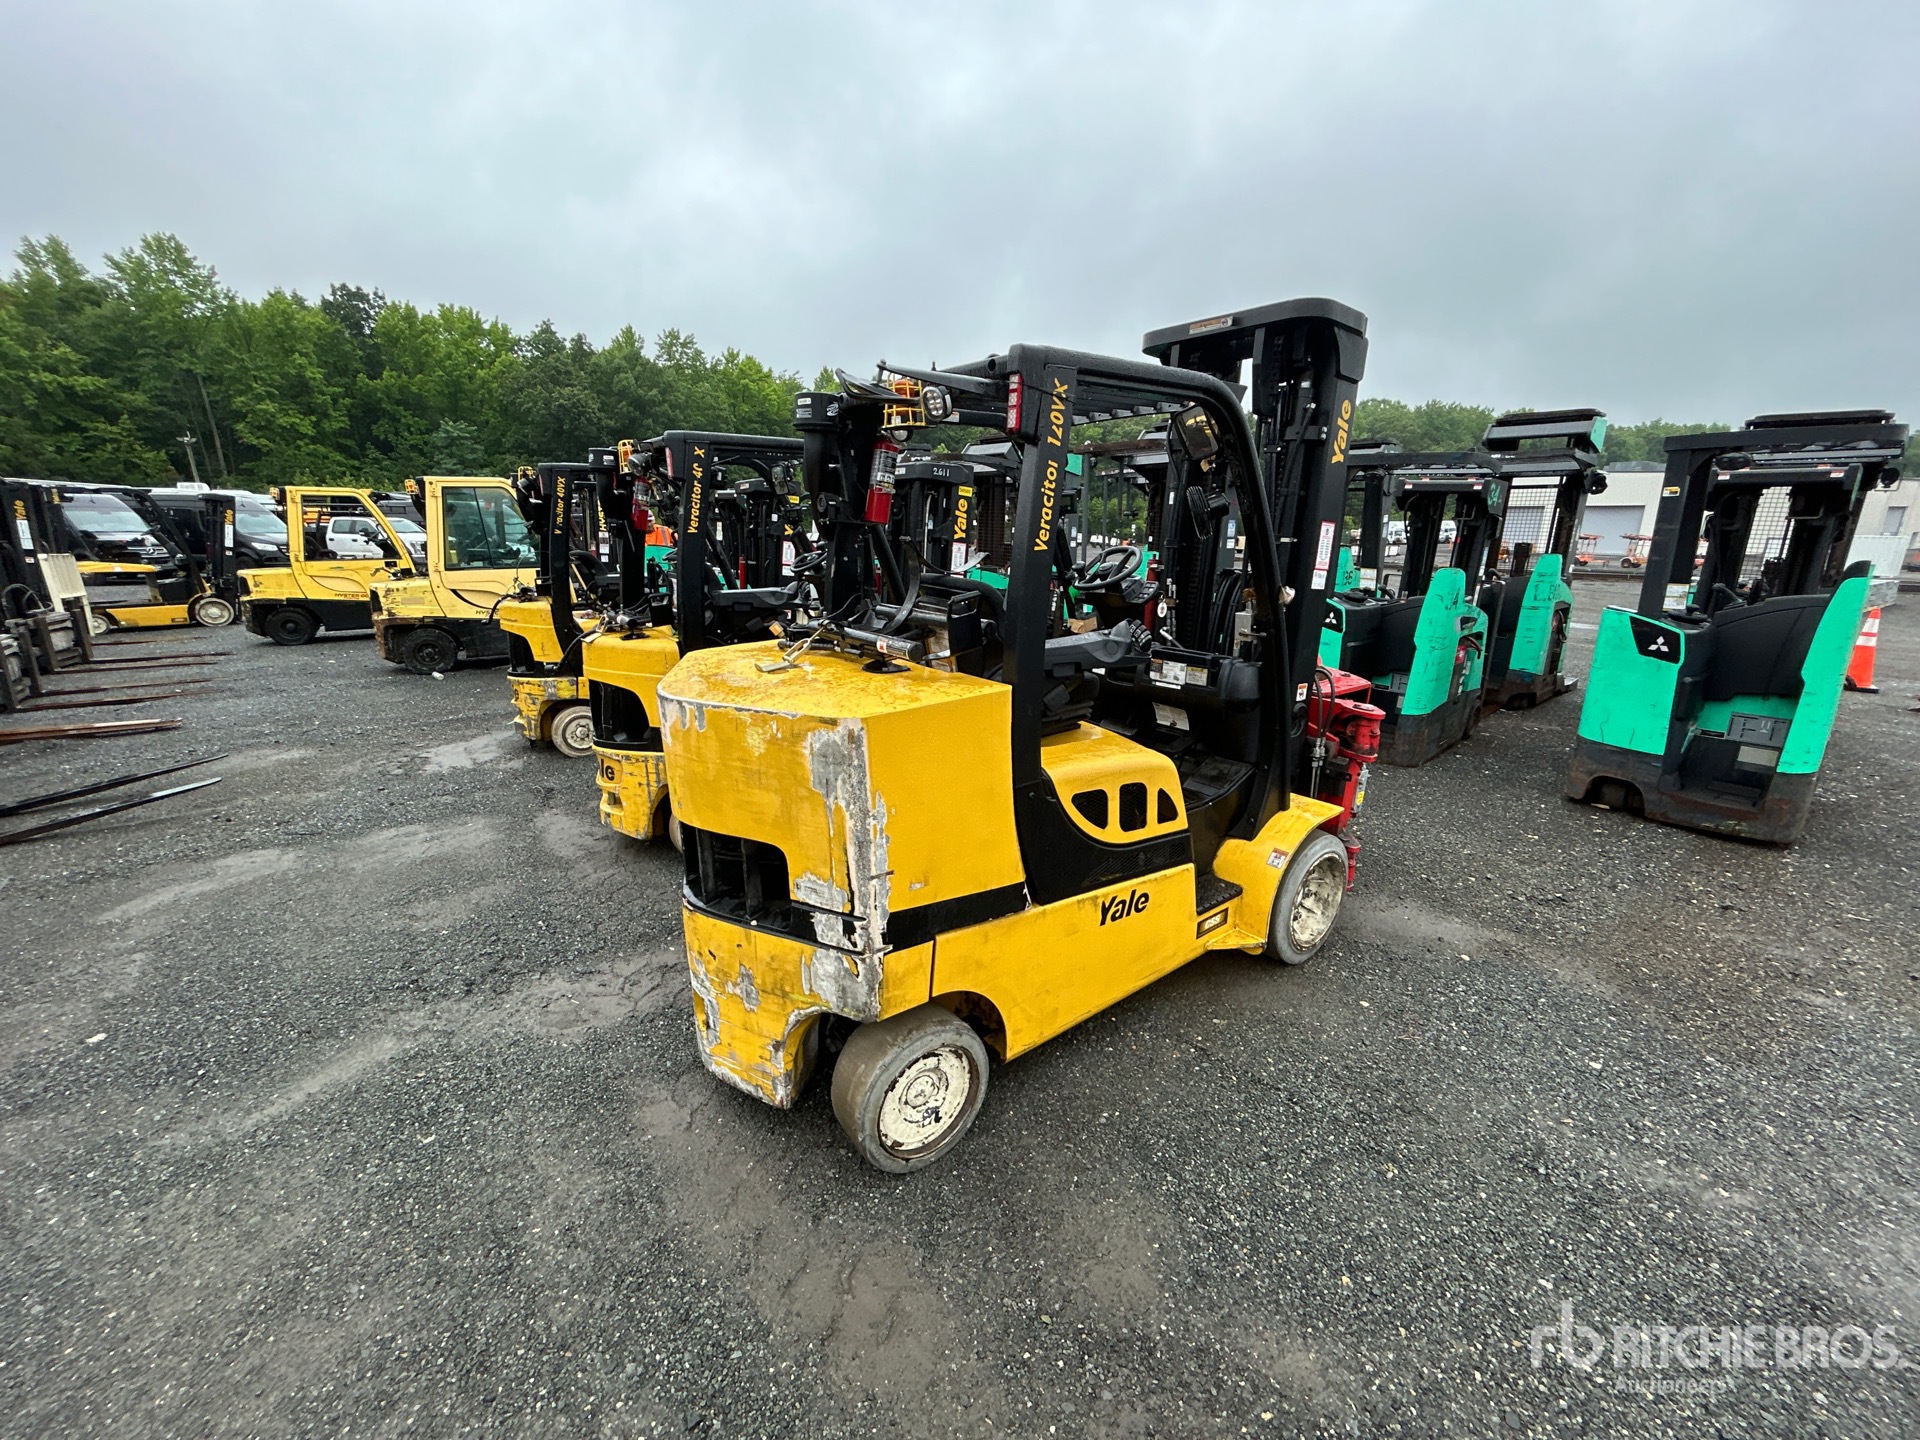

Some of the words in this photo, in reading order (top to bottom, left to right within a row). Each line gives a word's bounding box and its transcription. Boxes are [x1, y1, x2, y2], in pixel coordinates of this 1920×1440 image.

[1331, 399, 1352, 463] Yale
[932, 467, 950, 477] 2611
[13, 499, 27, 520] Yale
[553, 498, 565, 535] Vracitor
[687, 480, 702, 533] Veracitor
[953, 498, 968, 540] Yale
[1034, 459, 1059, 551] Veracitor
[1099, 888, 1150, 927] Yale
